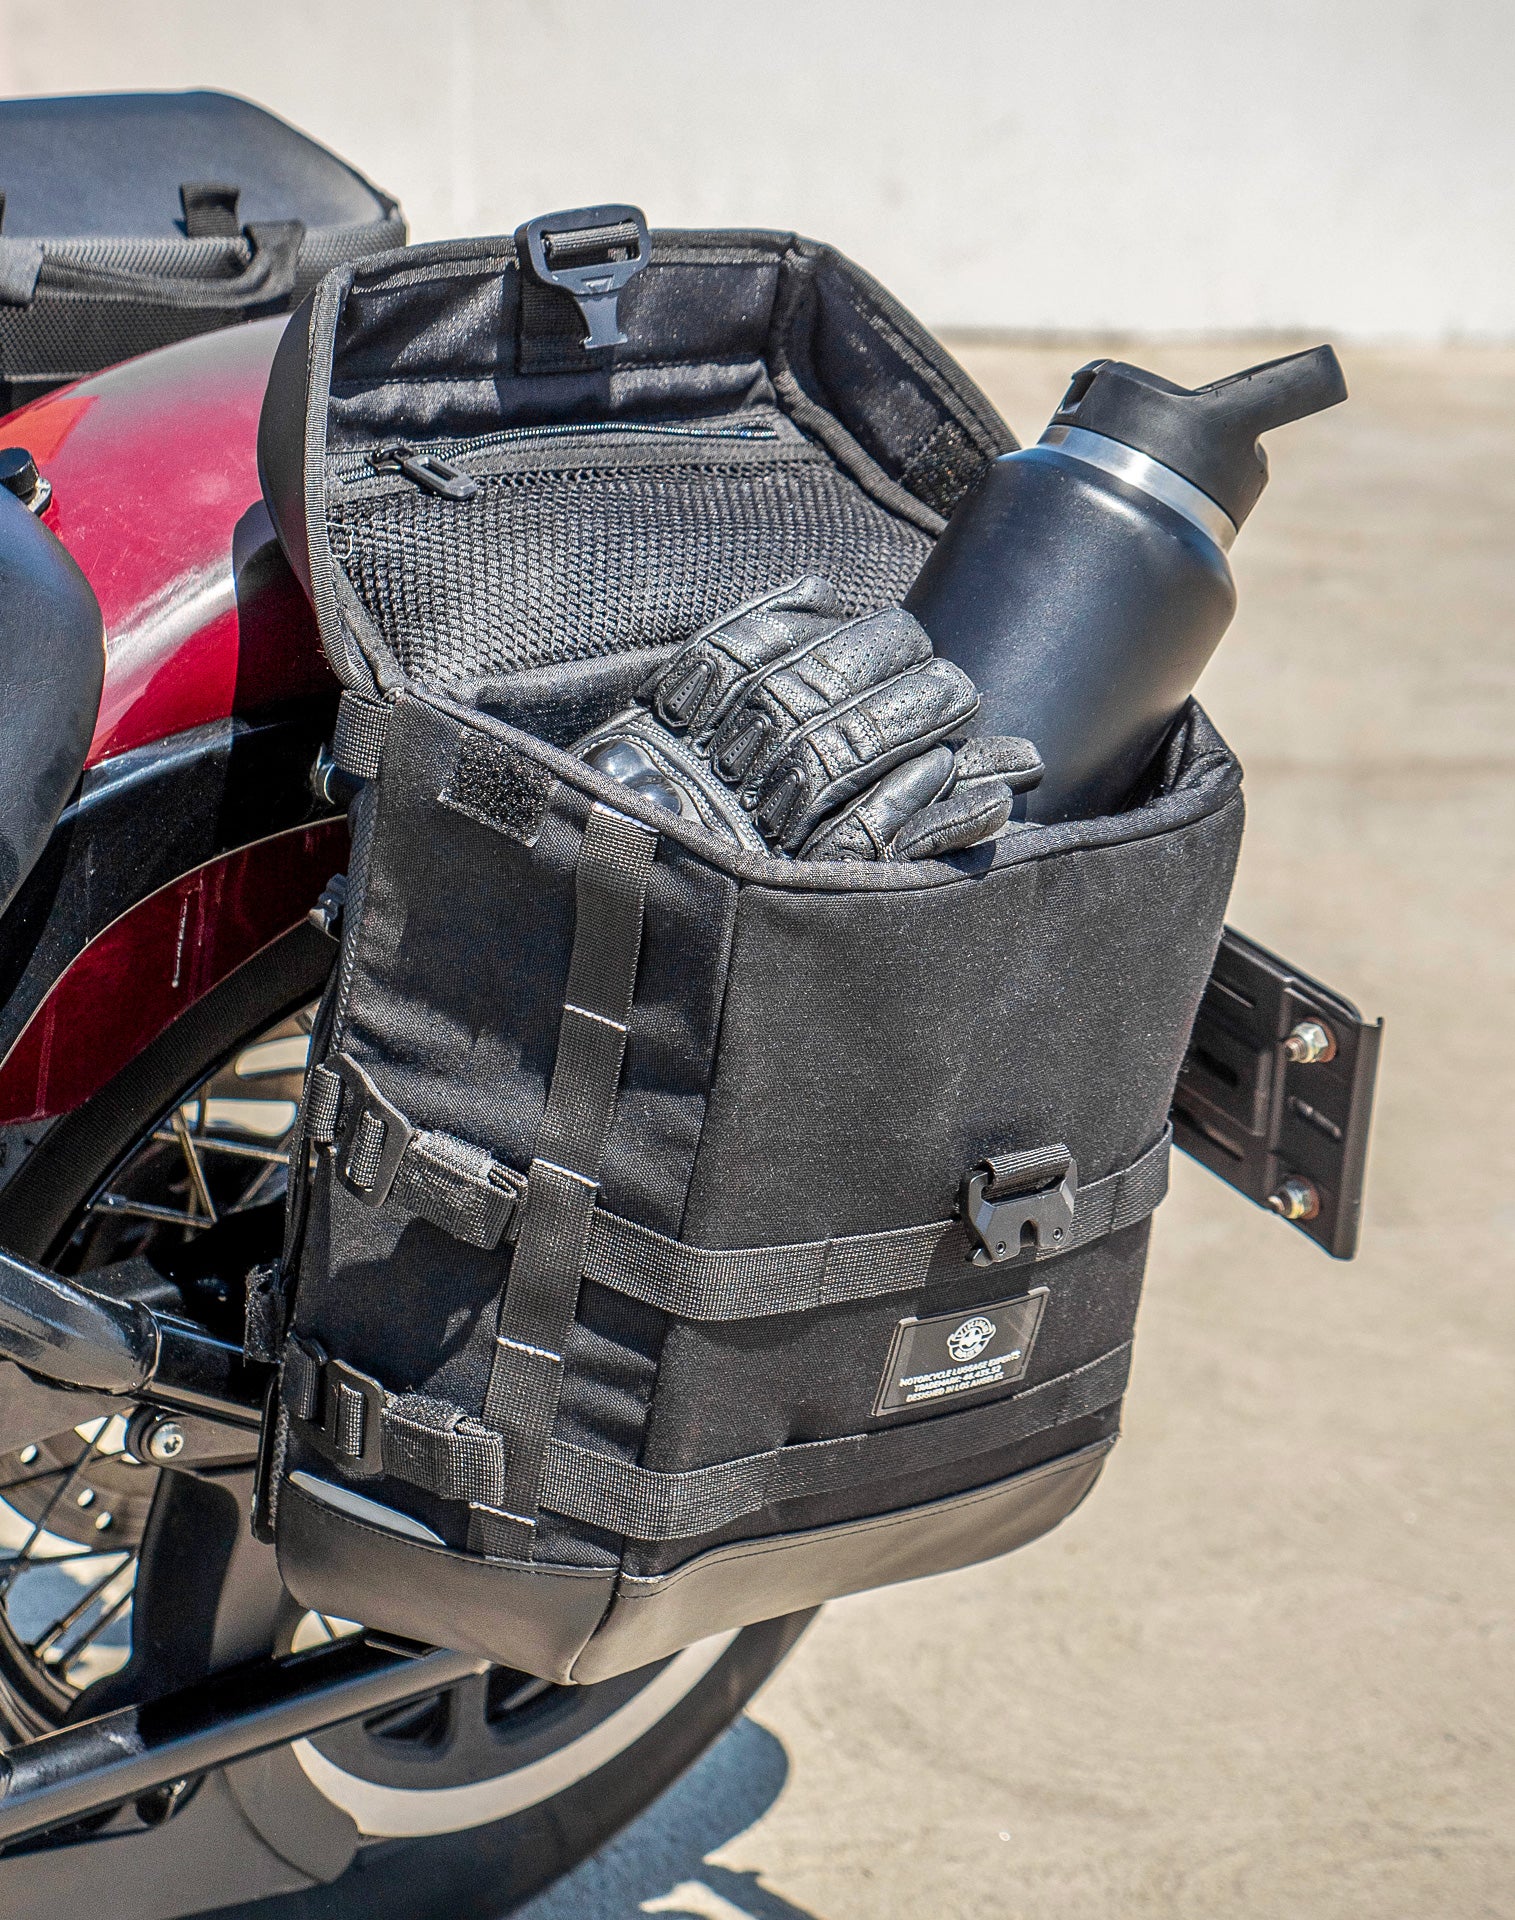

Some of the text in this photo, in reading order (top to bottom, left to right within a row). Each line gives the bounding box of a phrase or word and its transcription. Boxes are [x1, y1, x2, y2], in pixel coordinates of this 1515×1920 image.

[899, 1369, 952, 1387] MOTORCYCLE
[952, 1360, 988, 1376] LUGGAGE
[945, 1385, 955, 1394] IN
[954, 1381, 971, 1392] LOS
